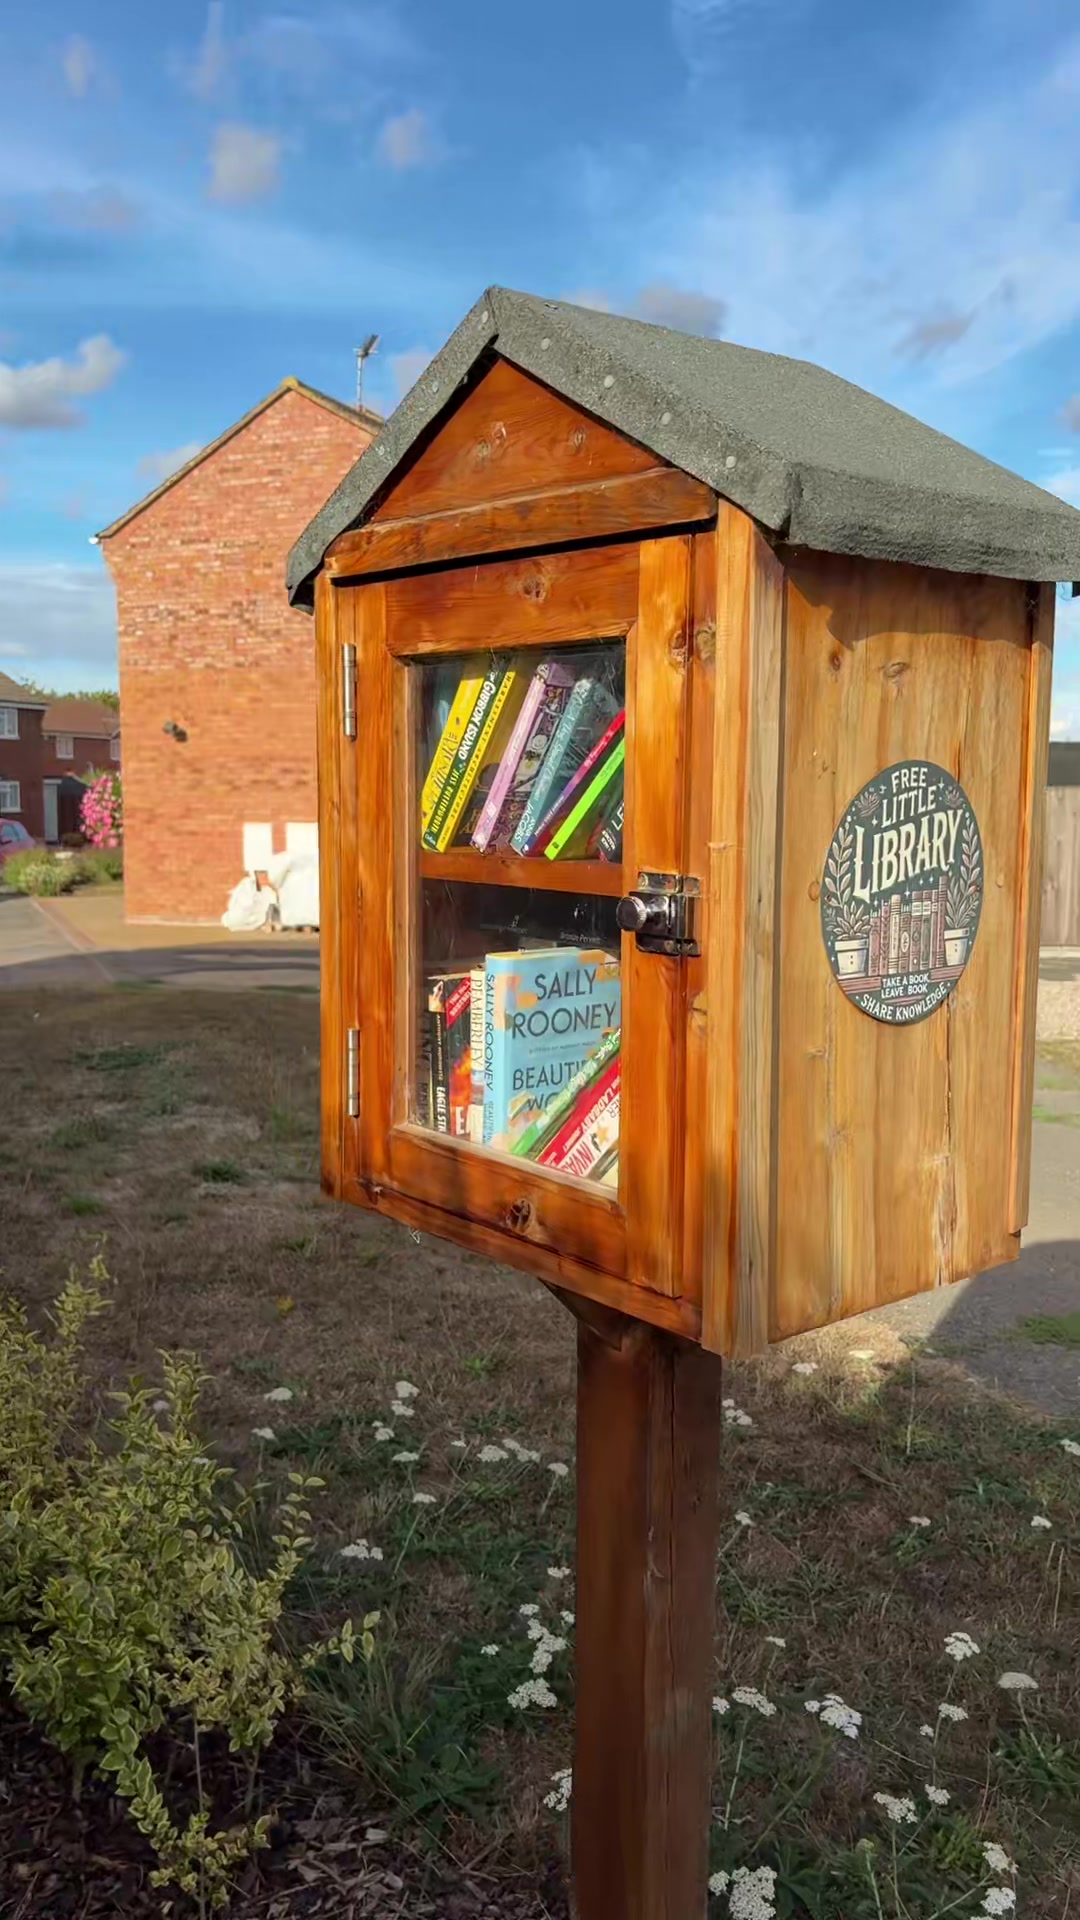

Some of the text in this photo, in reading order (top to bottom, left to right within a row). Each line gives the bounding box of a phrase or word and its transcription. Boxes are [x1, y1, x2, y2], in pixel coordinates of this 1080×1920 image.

[471, 682, 497, 724] GIBBON
[457, 722, 479, 760] ISLAND
[448, 768, 460, 785] JESS
[891, 767, 928, 793] FREE
[514, 802, 535, 842] JACOBS
[881, 786, 937, 828] LITTLE
[523, 816, 535, 838] ANNA
[853, 809, 963, 904] LIBRARY
[535, 968, 597, 1001] SALLY
[861, 981, 947, 1021] SHARE KNOWLEDGE
[882, 975, 929, 988] TAKE A BOOK
[882, 984, 928, 999] LEAVE BOOK
[470, 979, 482, 1066] PEMBERLEY
[484, 973, 494, 1091] SALLY ROONEY
[512, 1001, 617, 1039] ROONEY
[512, 1060, 587, 1091] BEAUTI
[436, 1086, 446, 1132] EAGLE STR
[581, 1088, 615, 1133] LADBABY
